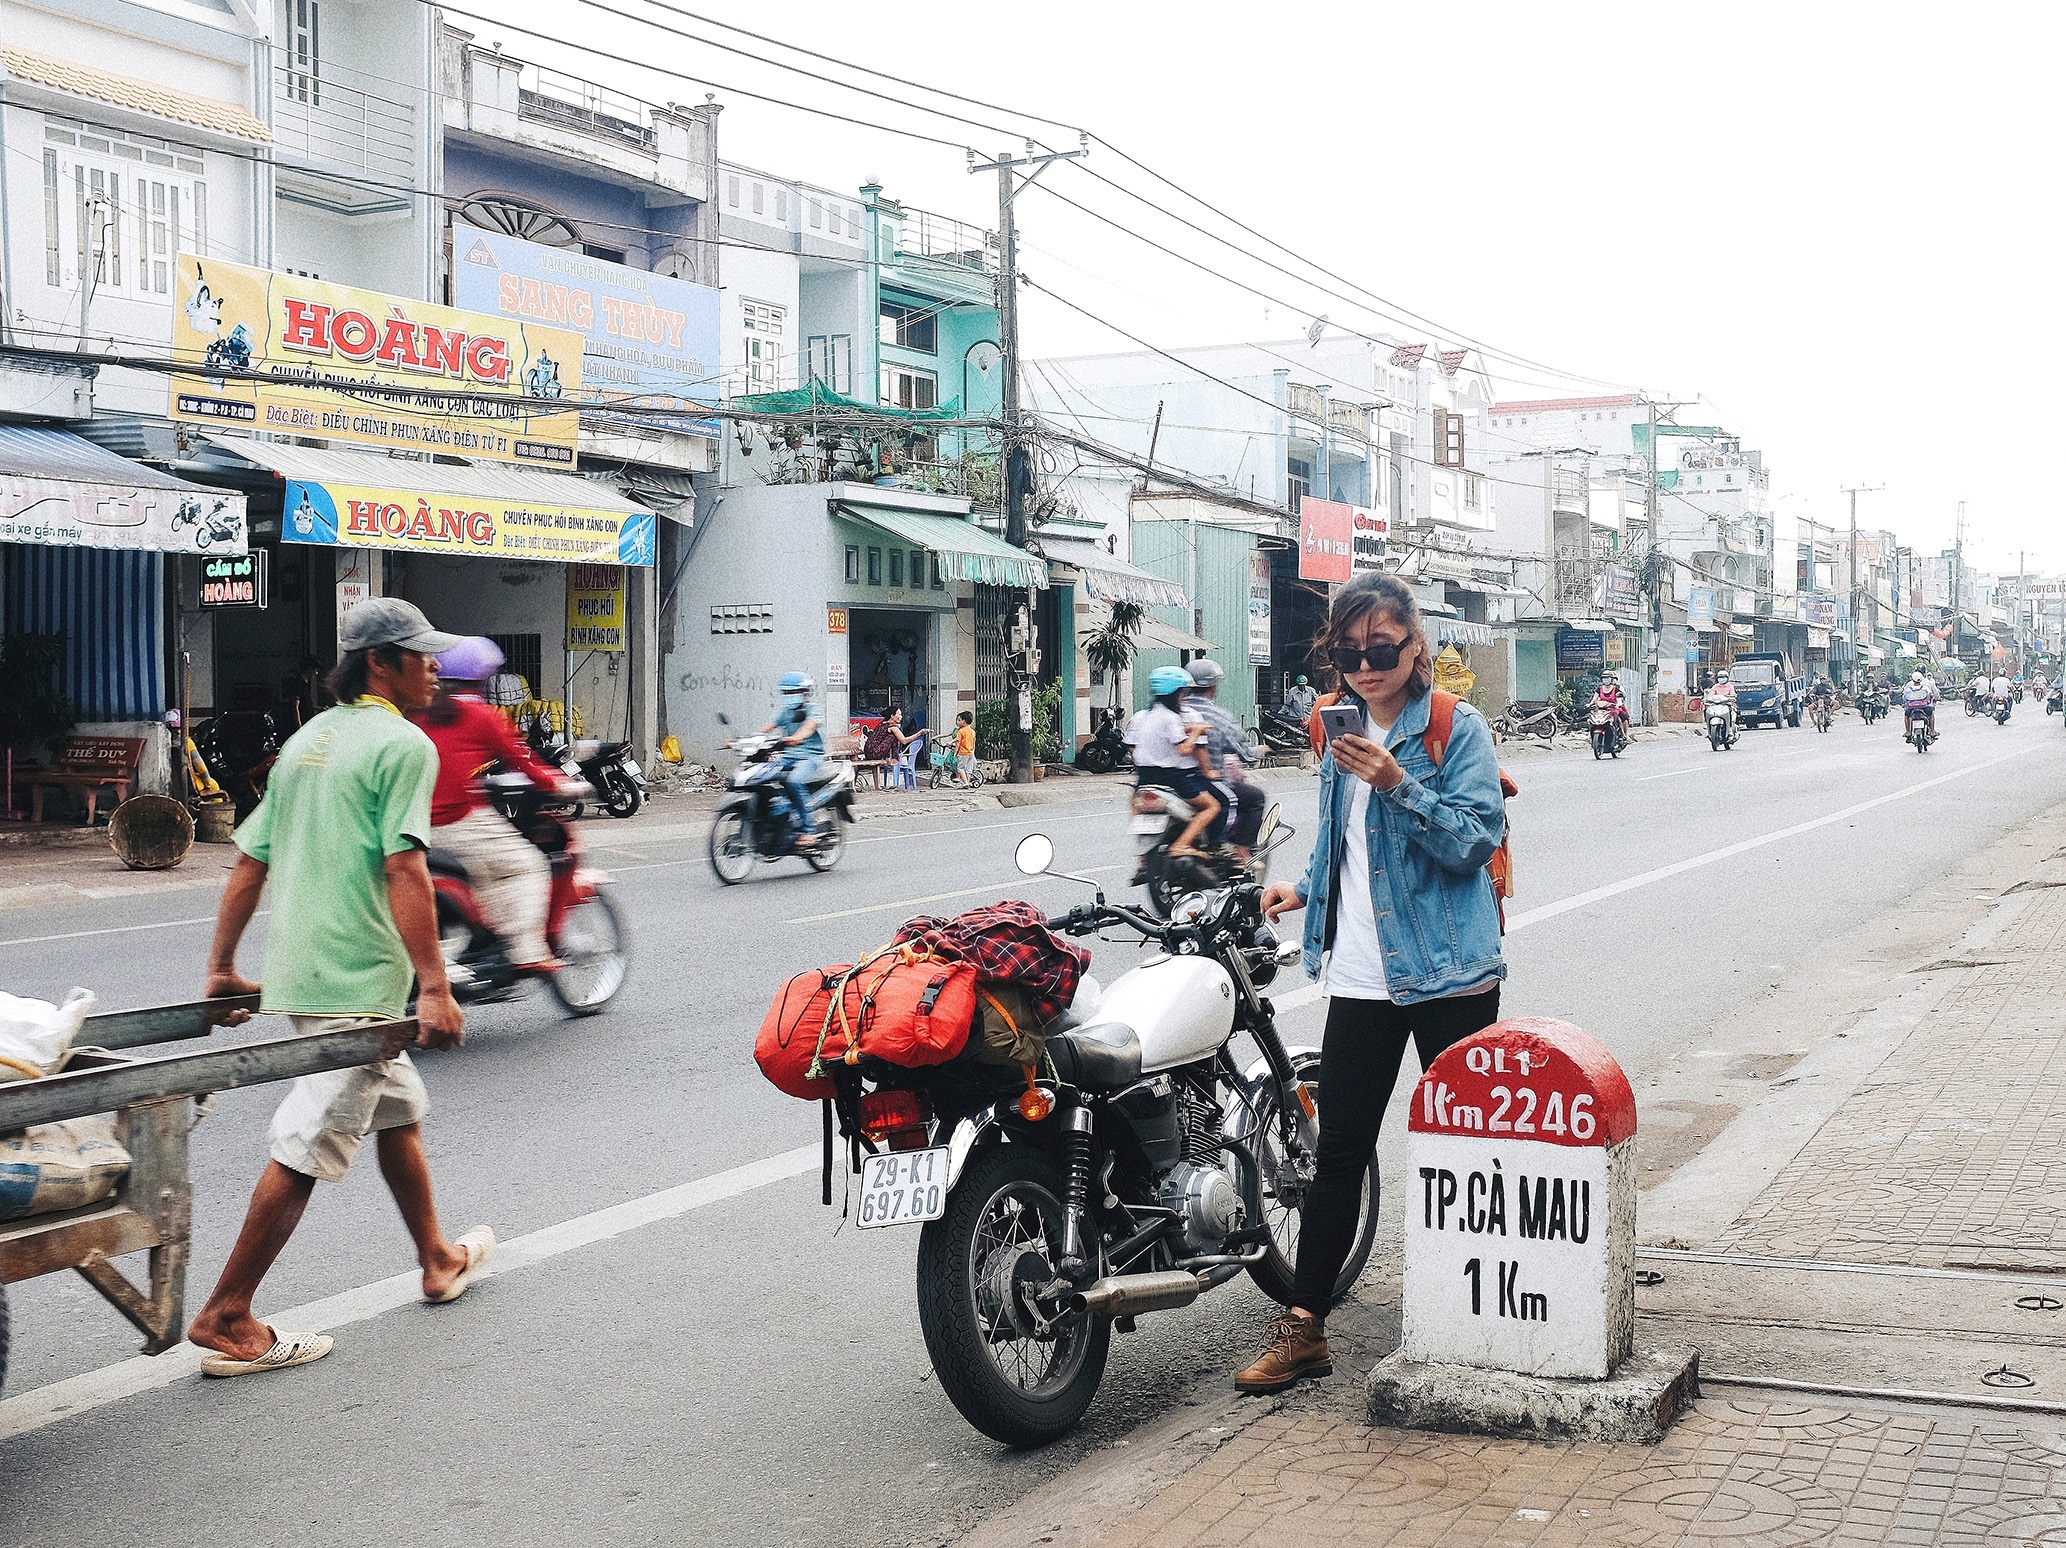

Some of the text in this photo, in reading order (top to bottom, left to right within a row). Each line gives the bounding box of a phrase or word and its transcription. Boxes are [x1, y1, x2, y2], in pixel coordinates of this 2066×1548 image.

[470, 249, 490, 264] ST
[499, 272, 687, 349] SANG THÙY
[282, 297, 511, 384] HOÀNG
[266, 404, 289, 427] Đặc
[321, 407, 350, 430] ĐIỀU
[390, 421, 420, 440] PHUN
[18, 524, 32, 535] xe
[57, 524, 83, 541] máy
[346, 497, 495, 544] HOÀNG
[605, 519, 618, 533] CON
[203, 577, 254, 603] HOÀNG
[578, 598, 599, 620] PHỤC
[828, 611, 846, 628] 378
[606, 627, 620, 645] CON
[66, 746, 127, 759] THẾ DUY
[872, 1152, 935, 1189] 29-K1
[862, 1184, 940, 1223] 697.60
[1519, 1175, 1590, 1245] MAU
[1463, 1257, 1548, 1323] 1 Km
